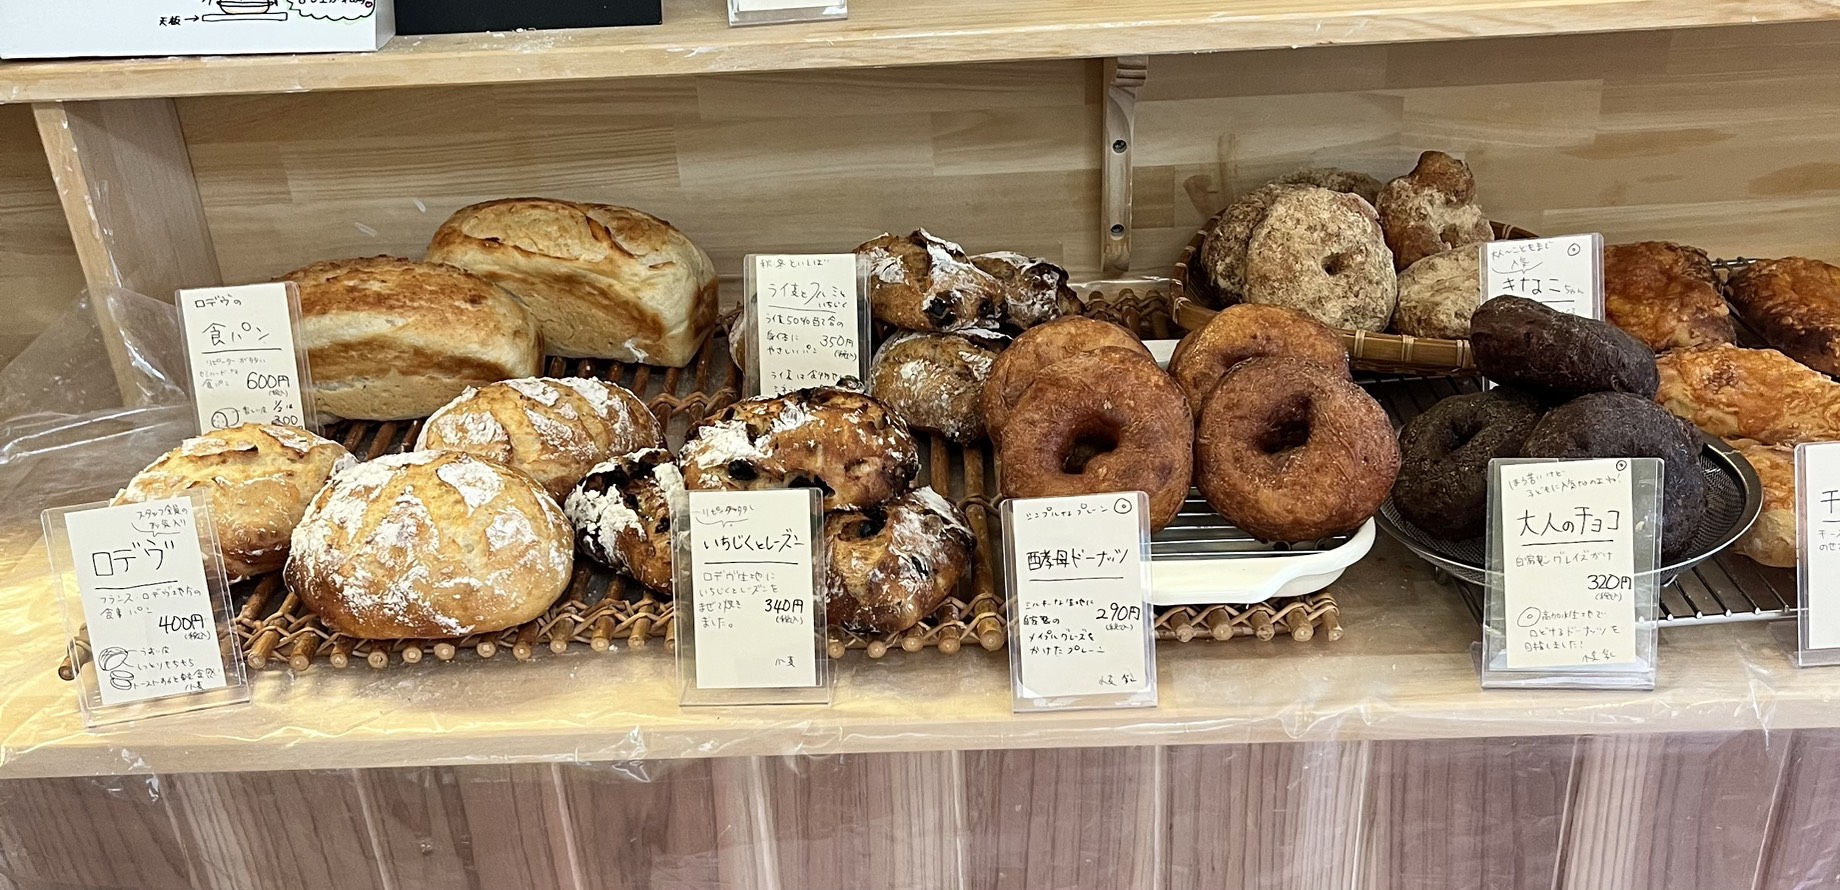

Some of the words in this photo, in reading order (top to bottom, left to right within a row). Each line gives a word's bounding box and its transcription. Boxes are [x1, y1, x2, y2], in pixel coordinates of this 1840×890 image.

[159, 16, 181, 26] 天板
[195, 293, 242, 308] ロデヴの
[202, 322, 270, 346] 食パン
[820, 335, 854, 348] 350円
[246, 371, 290, 390] 600円
[1516, 506, 1620, 537] 大人のチョコ
[703, 527, 805, 553] いちじくとレーズン
[1818, 542, 1840, 551] のせ
[92, 538, 175, 577] ロデヴ
[1026, 547, 1129, 571] 酵母ドーナッツ
[703, 570, 775, 582] ロデヴ生地に
[1587, 573, 1632, 590] 320円
[698, 583, 779, 598] いちじくとレーズンを
[764, 598, 804, 614] 340円
[1095, 602, 1140, 621] 290円
[159, 613, 205, 635] 400円
[701, 616, 734, 628] ました。
[1030, 644, 1105, 656] かけたプレーン
[774, 655, 797, 668] 小麦
